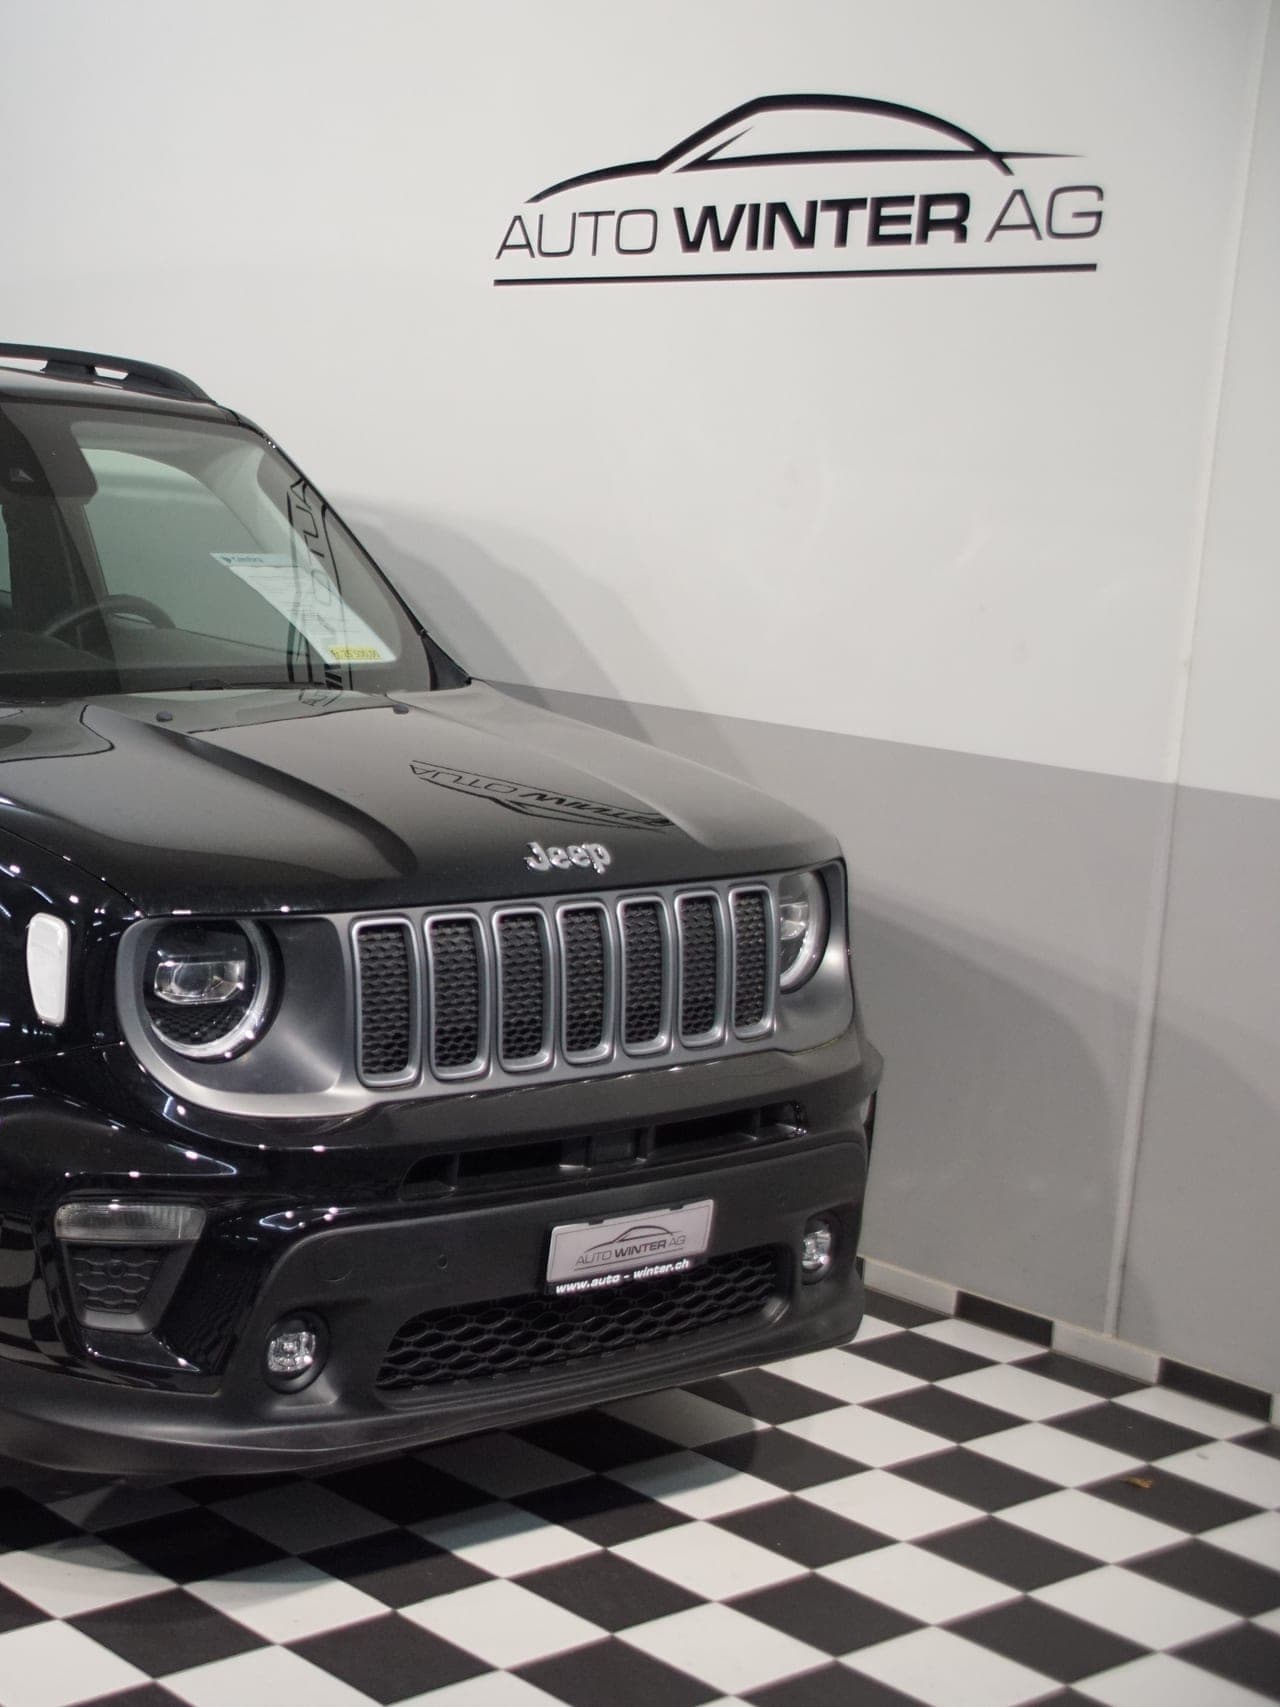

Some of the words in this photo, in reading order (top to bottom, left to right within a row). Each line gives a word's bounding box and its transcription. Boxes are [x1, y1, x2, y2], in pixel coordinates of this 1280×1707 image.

[495, 208, 658, 260] AUTO
[673, 192, 971, 253] WINTER
[985, 185, 1105, 243] AG
[524, 841, 611, 875] Jeep
[575, 1251, 612, 1266] AUTO
[614, 1239, 667, 1258] WINTER
[668, 1235, 686, 1247] AG
